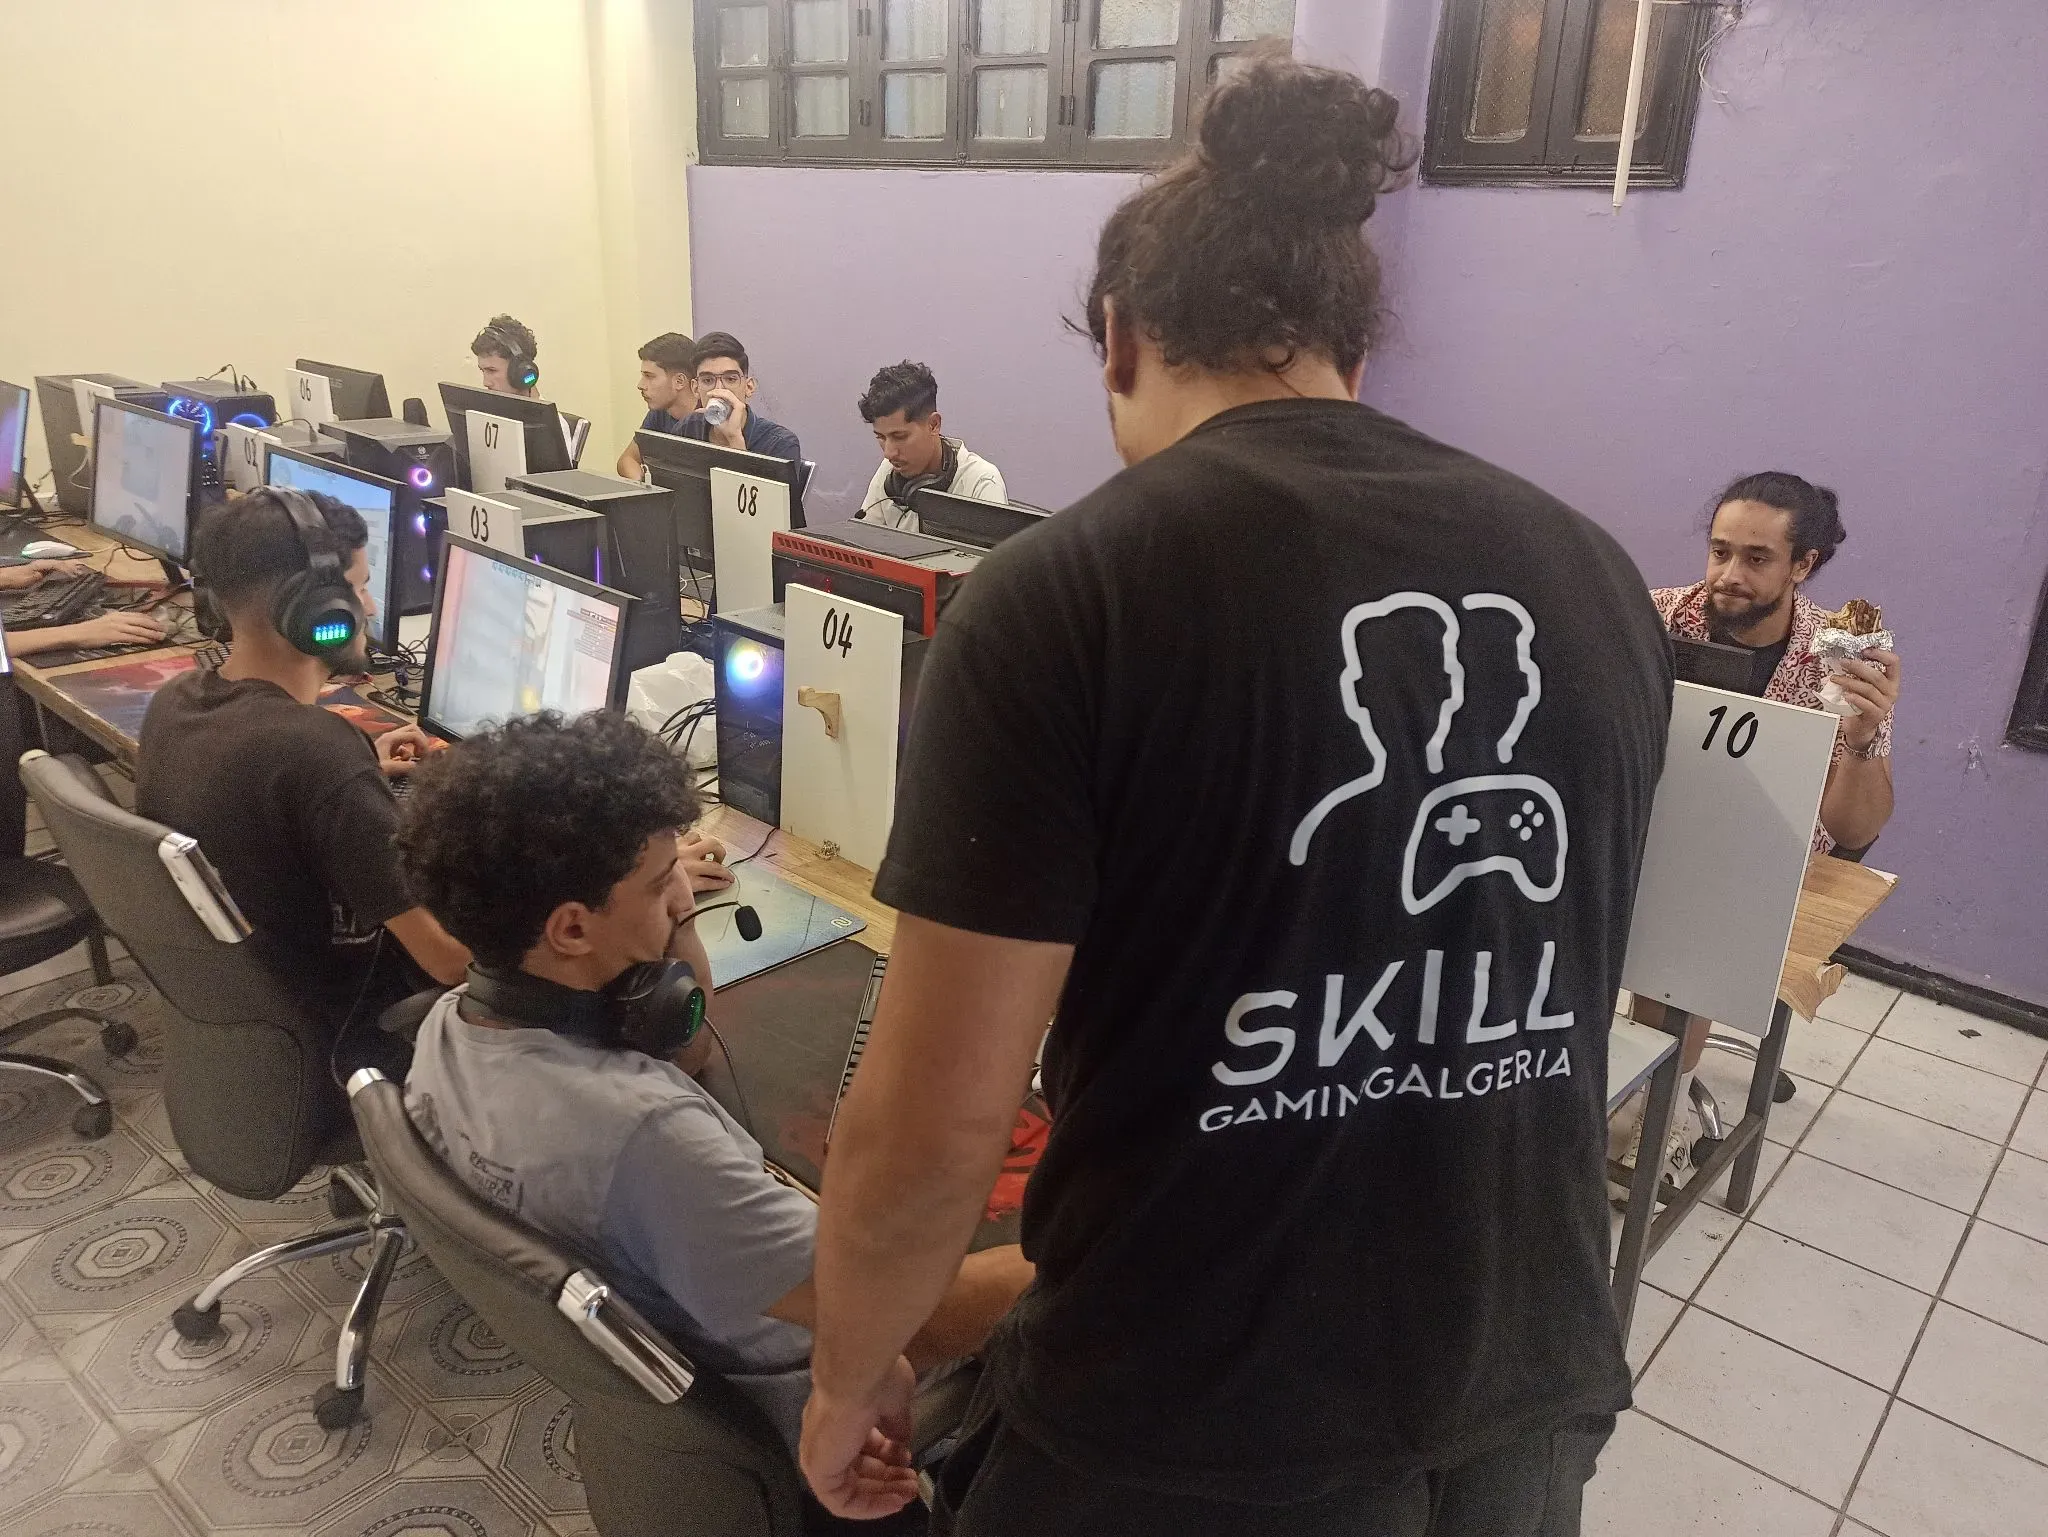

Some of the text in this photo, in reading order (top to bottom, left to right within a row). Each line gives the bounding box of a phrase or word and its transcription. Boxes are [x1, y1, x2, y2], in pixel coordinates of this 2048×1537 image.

[300, 377, 312, 402] 06
[484, 421, 499, 449] 07
[737, 484, 759, 517] 08
[470, 505, 489, 542] 03
[822, 607, 853, 659] 04
[1701, 705, 1759, 759] 10
[1211, 940, 1575, 1086] SKILL
